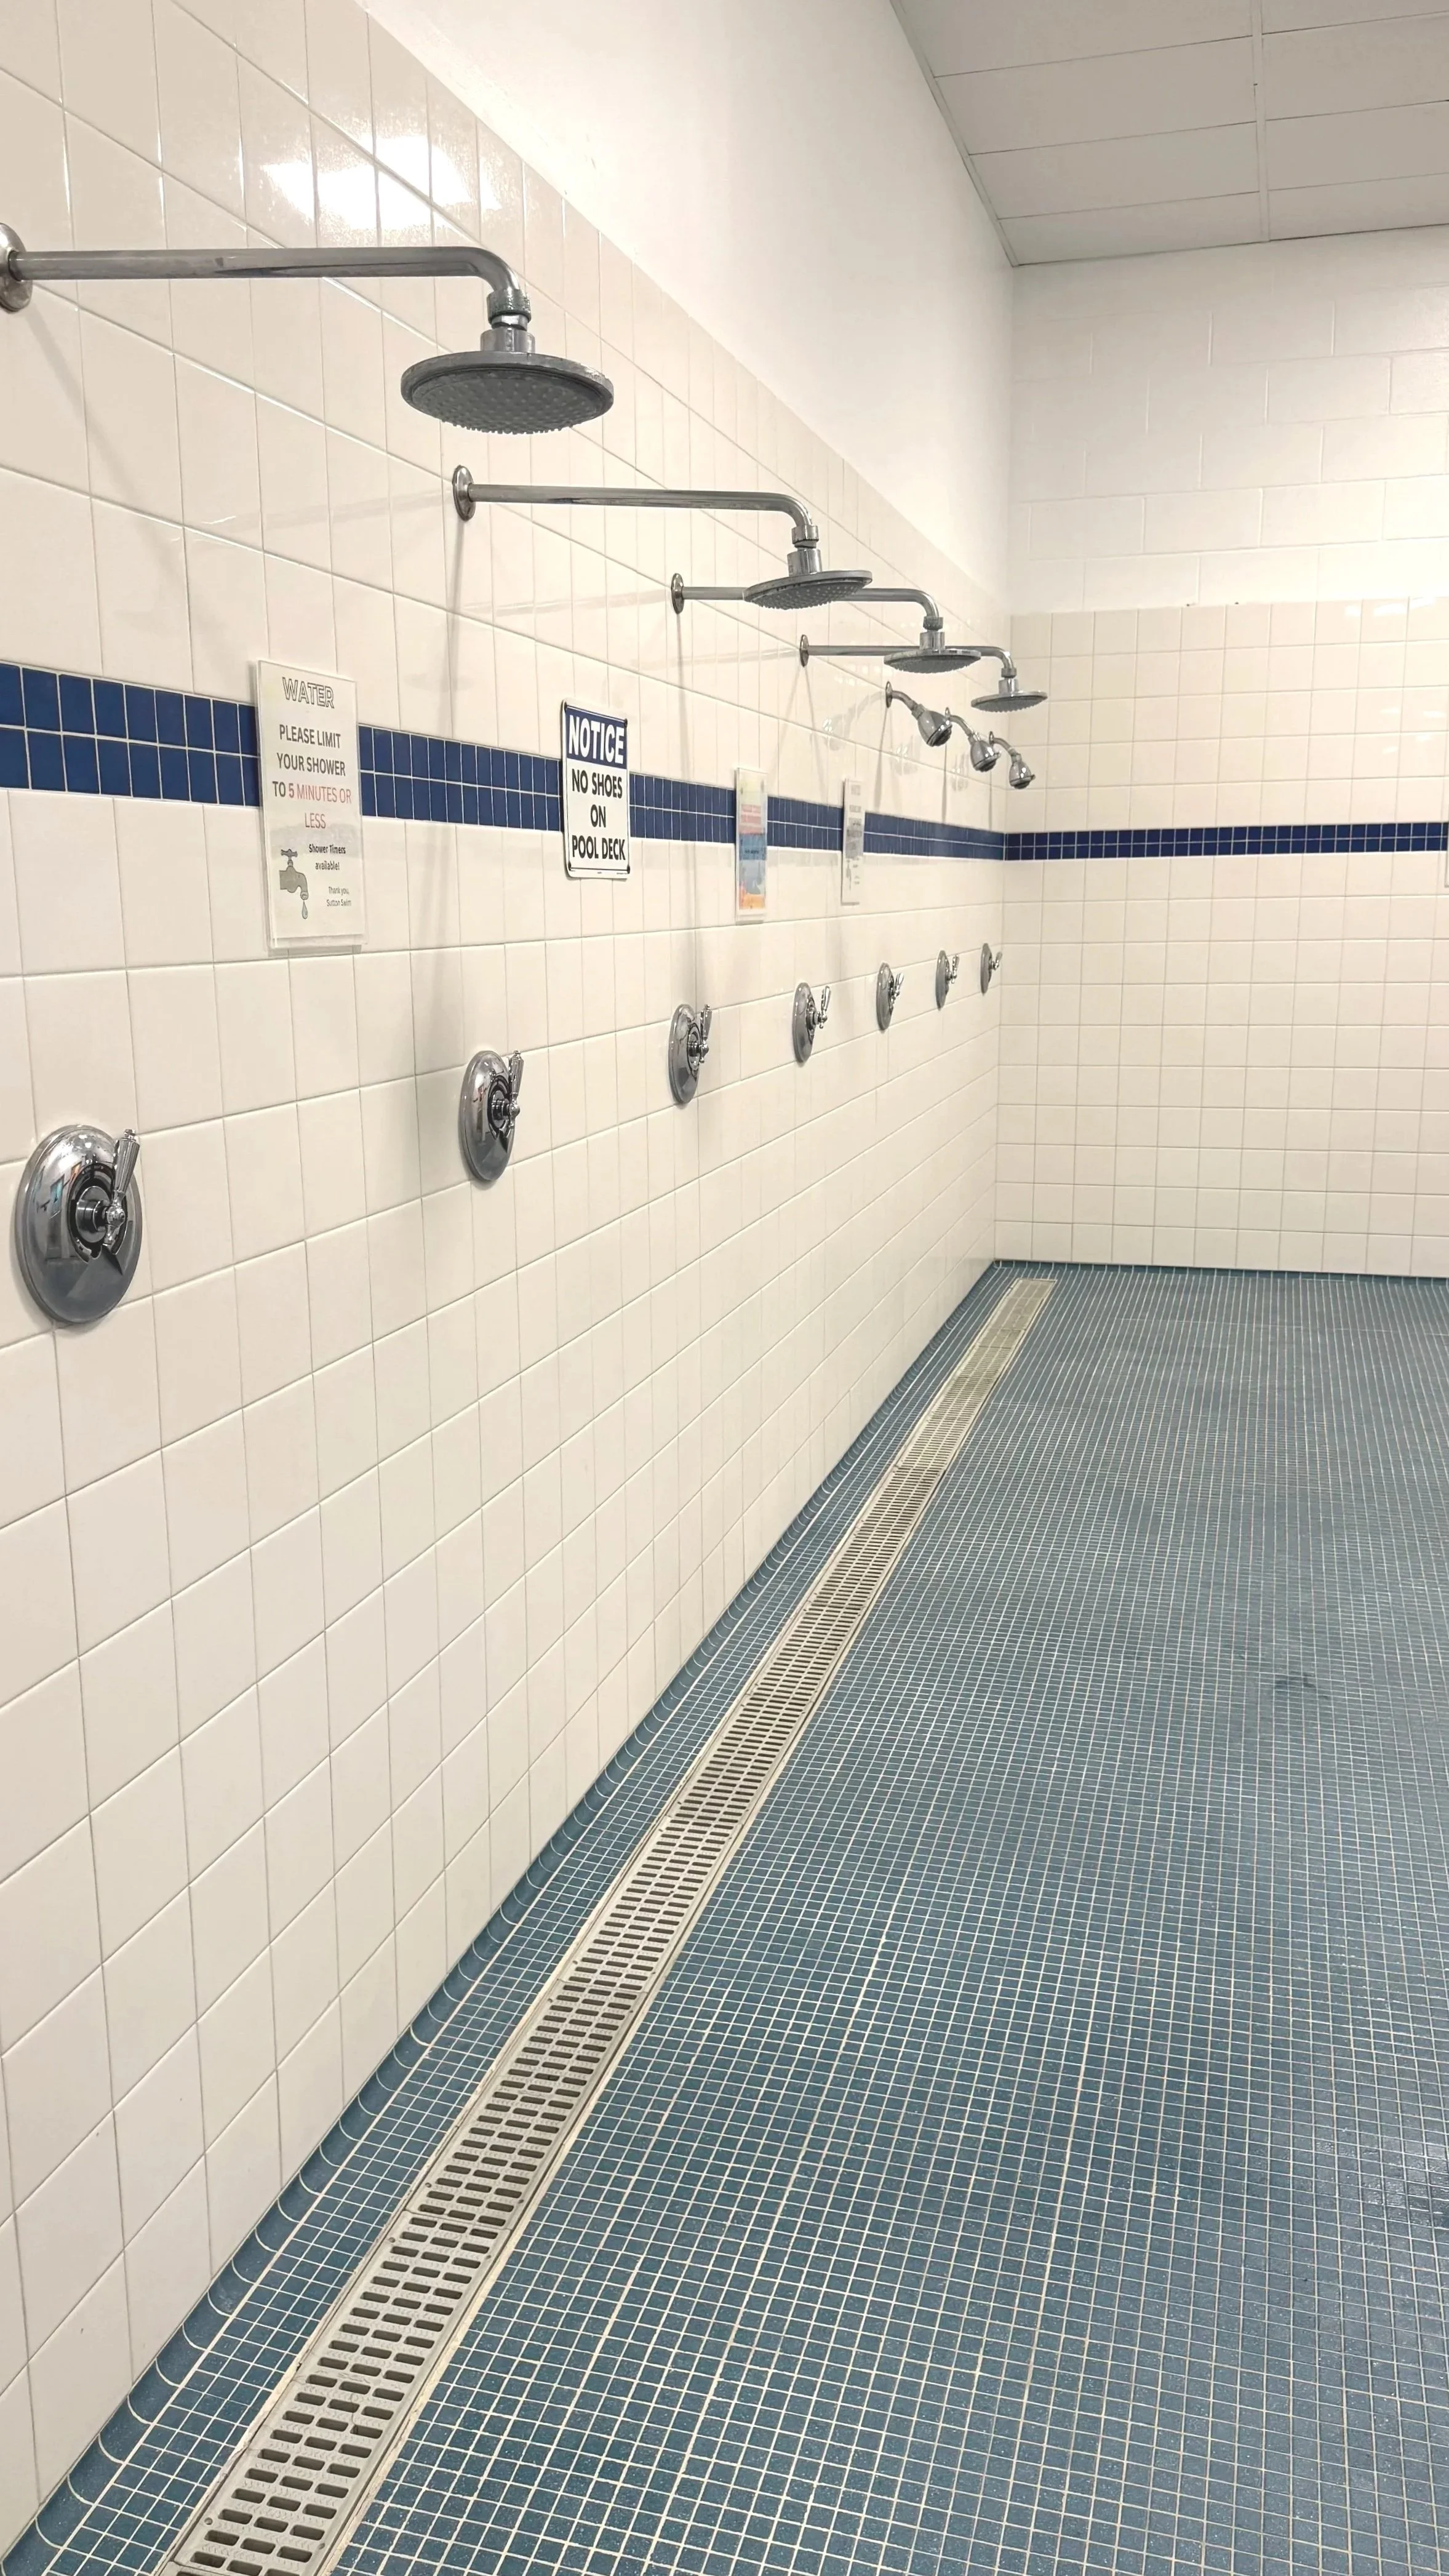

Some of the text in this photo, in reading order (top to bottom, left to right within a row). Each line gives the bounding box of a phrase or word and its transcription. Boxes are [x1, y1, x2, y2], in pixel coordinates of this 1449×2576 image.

[282, 677, 334, 708] WATER
[279, 724, 341, 748] PLEASE LIMIT
[569, 714, 625, 764] NOTICE
[277, 753, 345, 776] YOUR SHOWER
[272, 781, 351, 804] TO 5 MINUTES OR
[572, 768, 623, 799] NO SHOES
[305, 812, 326, 829] LESS
[590, 804, 606, 828] ON
[309, 843, 328, 854] Shower
[572, 835, 626, 861] POOL DECK
